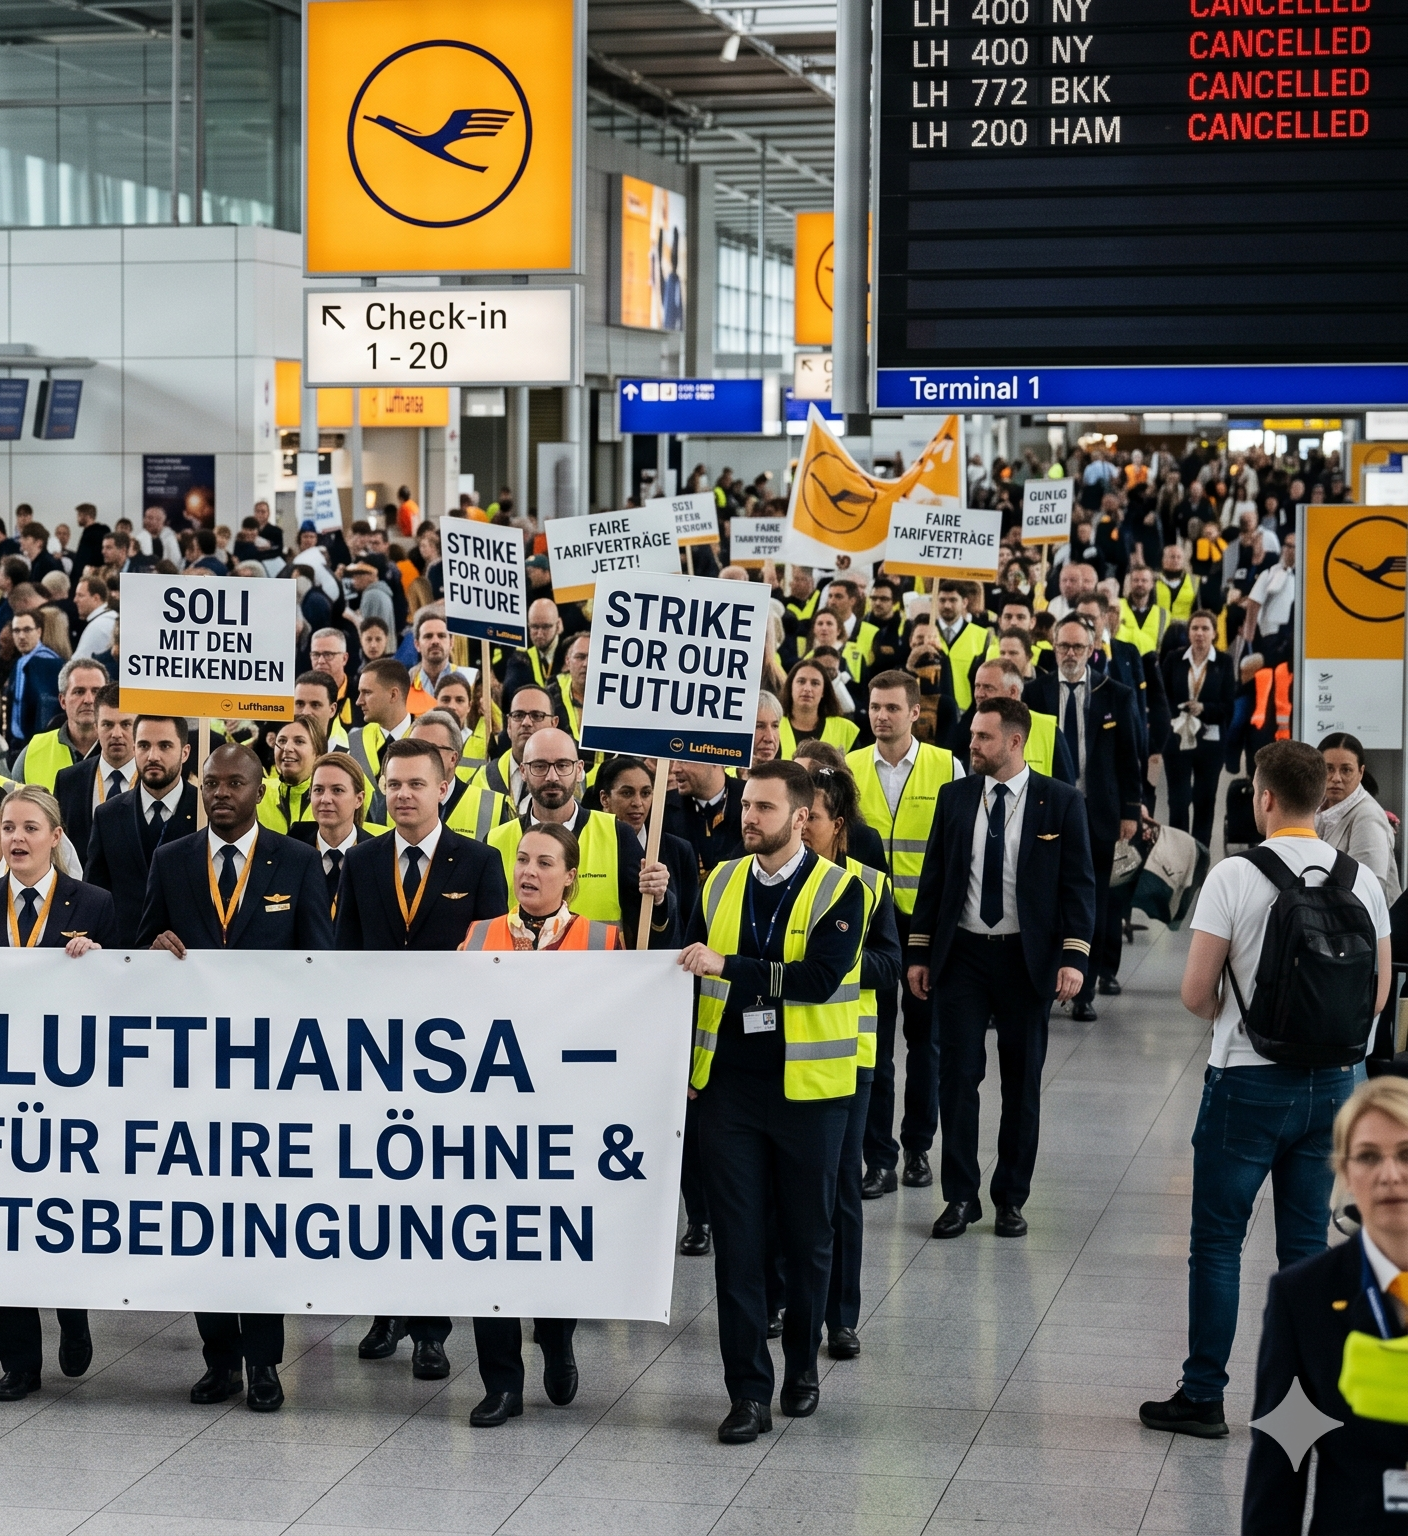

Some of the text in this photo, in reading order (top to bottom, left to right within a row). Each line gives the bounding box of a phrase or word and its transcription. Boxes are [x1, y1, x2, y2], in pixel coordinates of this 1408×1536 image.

[913, 0, 949, 27] LH
[971, 0, 1029, 25] 400
[1052, 0, 1092, 23] NY
[913, 26, 1371, 68] LH 400 NY CANCELLED
[912, 68, 1370, 108] LH 772 BKK CANCELLED
[912, 109, 1369, 149] LH 200 HAM CANCELLED
[365, 301, 508, 332] Check-in
[366, 343, 378, 370] 1
[408, 341, 449, 371] 20
[909, 375, 1040, 401] Terminal 1
[589, 518, 630, 537] FAIRE
[926, 512, 962, 527] FAIRE
[447, 531, 518, 565] STRIKE
[554, 531, 671, 560] TARIFVERTRÄGE
[919, 545, 963, 560] JETZT!
[449, 559, 518, 589] FOR OUR
[591, 554, 640, 574] JETZT!
[163, 587, 250, 626] SOLI
[450, 582, 520, 615] FUTURE
[605, 589, 755, 643] STRIKE
[159, 628, 252, 654] MIT DEN
[128, 655, 285, 682] STREIKENDEN
[600, 634, 750, 681] FOR OUR
[238, 701, 285, 712] Lufthansa
[596, 671, 746, 722] FUTURE
[124, 1119, 314, 1179] FAIRE
[338, 1108, 575, 1181] LÖHNE
[597, 1123, 648, 1181] &
